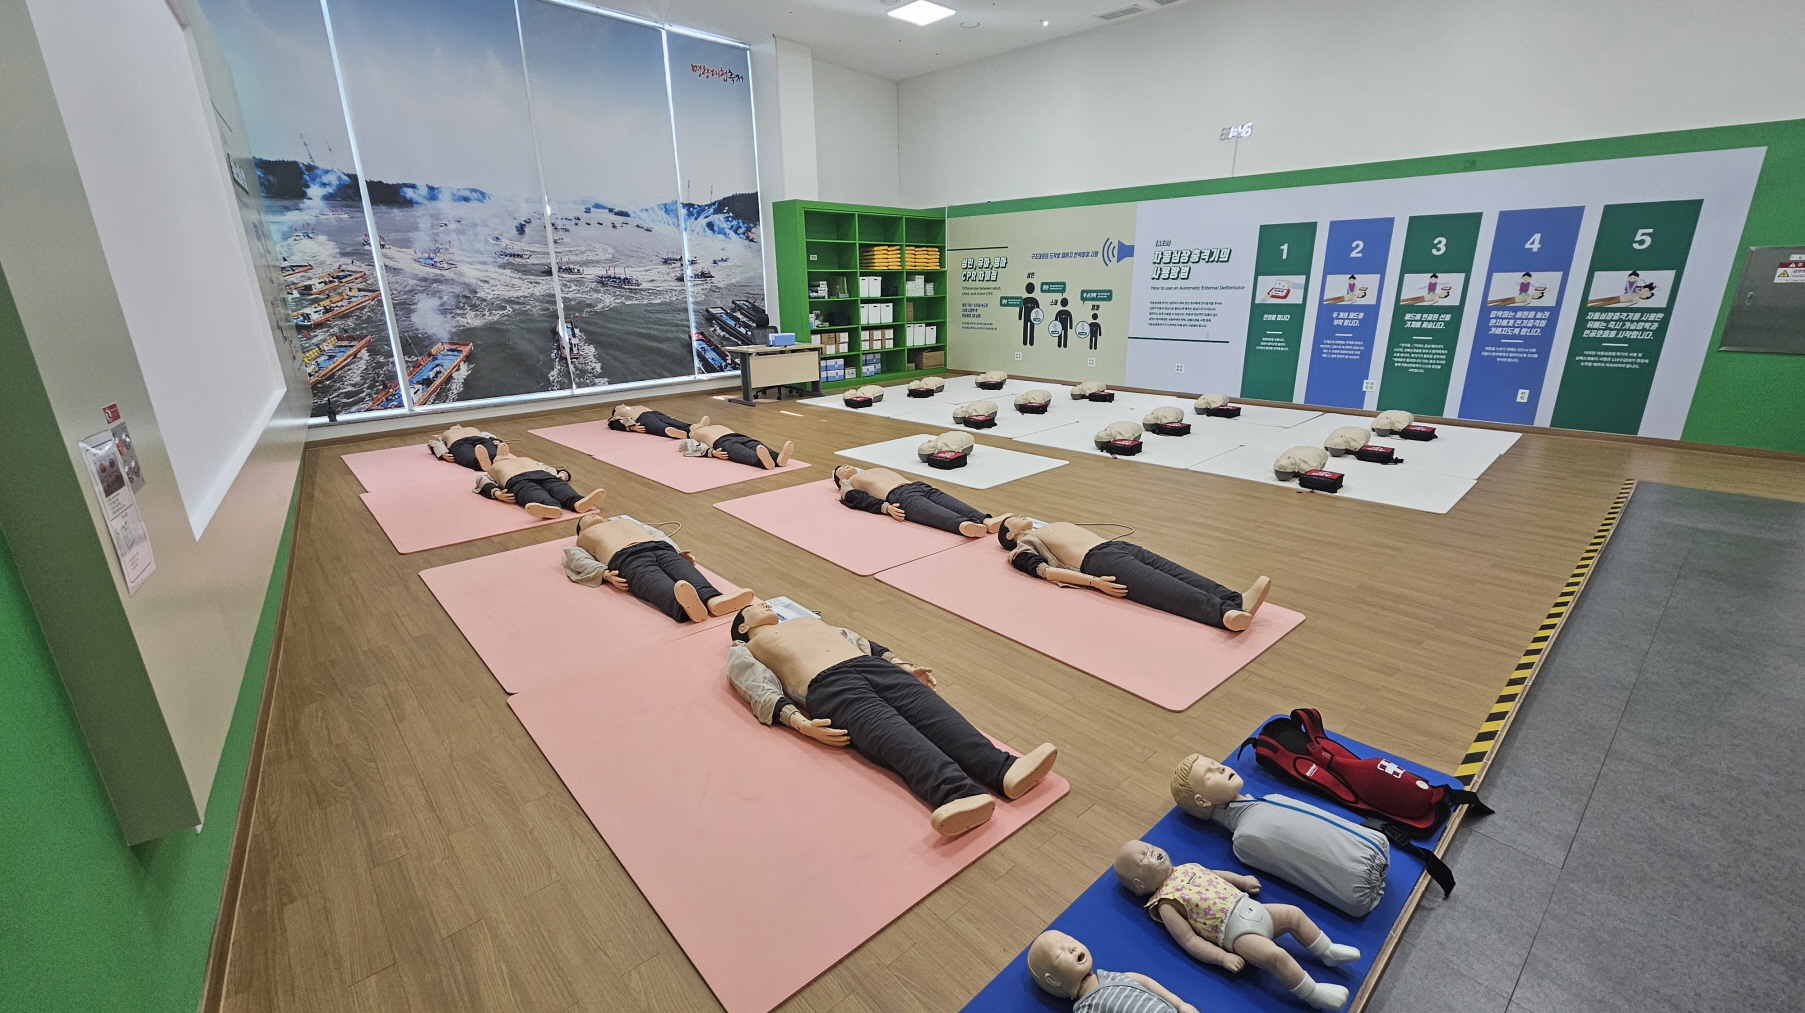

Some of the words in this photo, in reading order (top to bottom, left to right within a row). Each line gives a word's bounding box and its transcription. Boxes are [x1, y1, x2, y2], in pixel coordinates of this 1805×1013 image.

[1431, 237, 1446, 255] 3
[1525, 233, 1541, 252] 4
[1632, 228, 1654, 250] 5
[1152, 247, 1232, 265] 자동심장충격기의
[1281, 244, 1288, 260] 1
[1350, 240, 1363, 257] 2
[961, 258, 977, 270] 성인,
[961, 271, 977, 282] CPR
[1151, 265, 1191, 280] 사용방법
[1585, 311, 1641, 320] 자동심장충격기를
